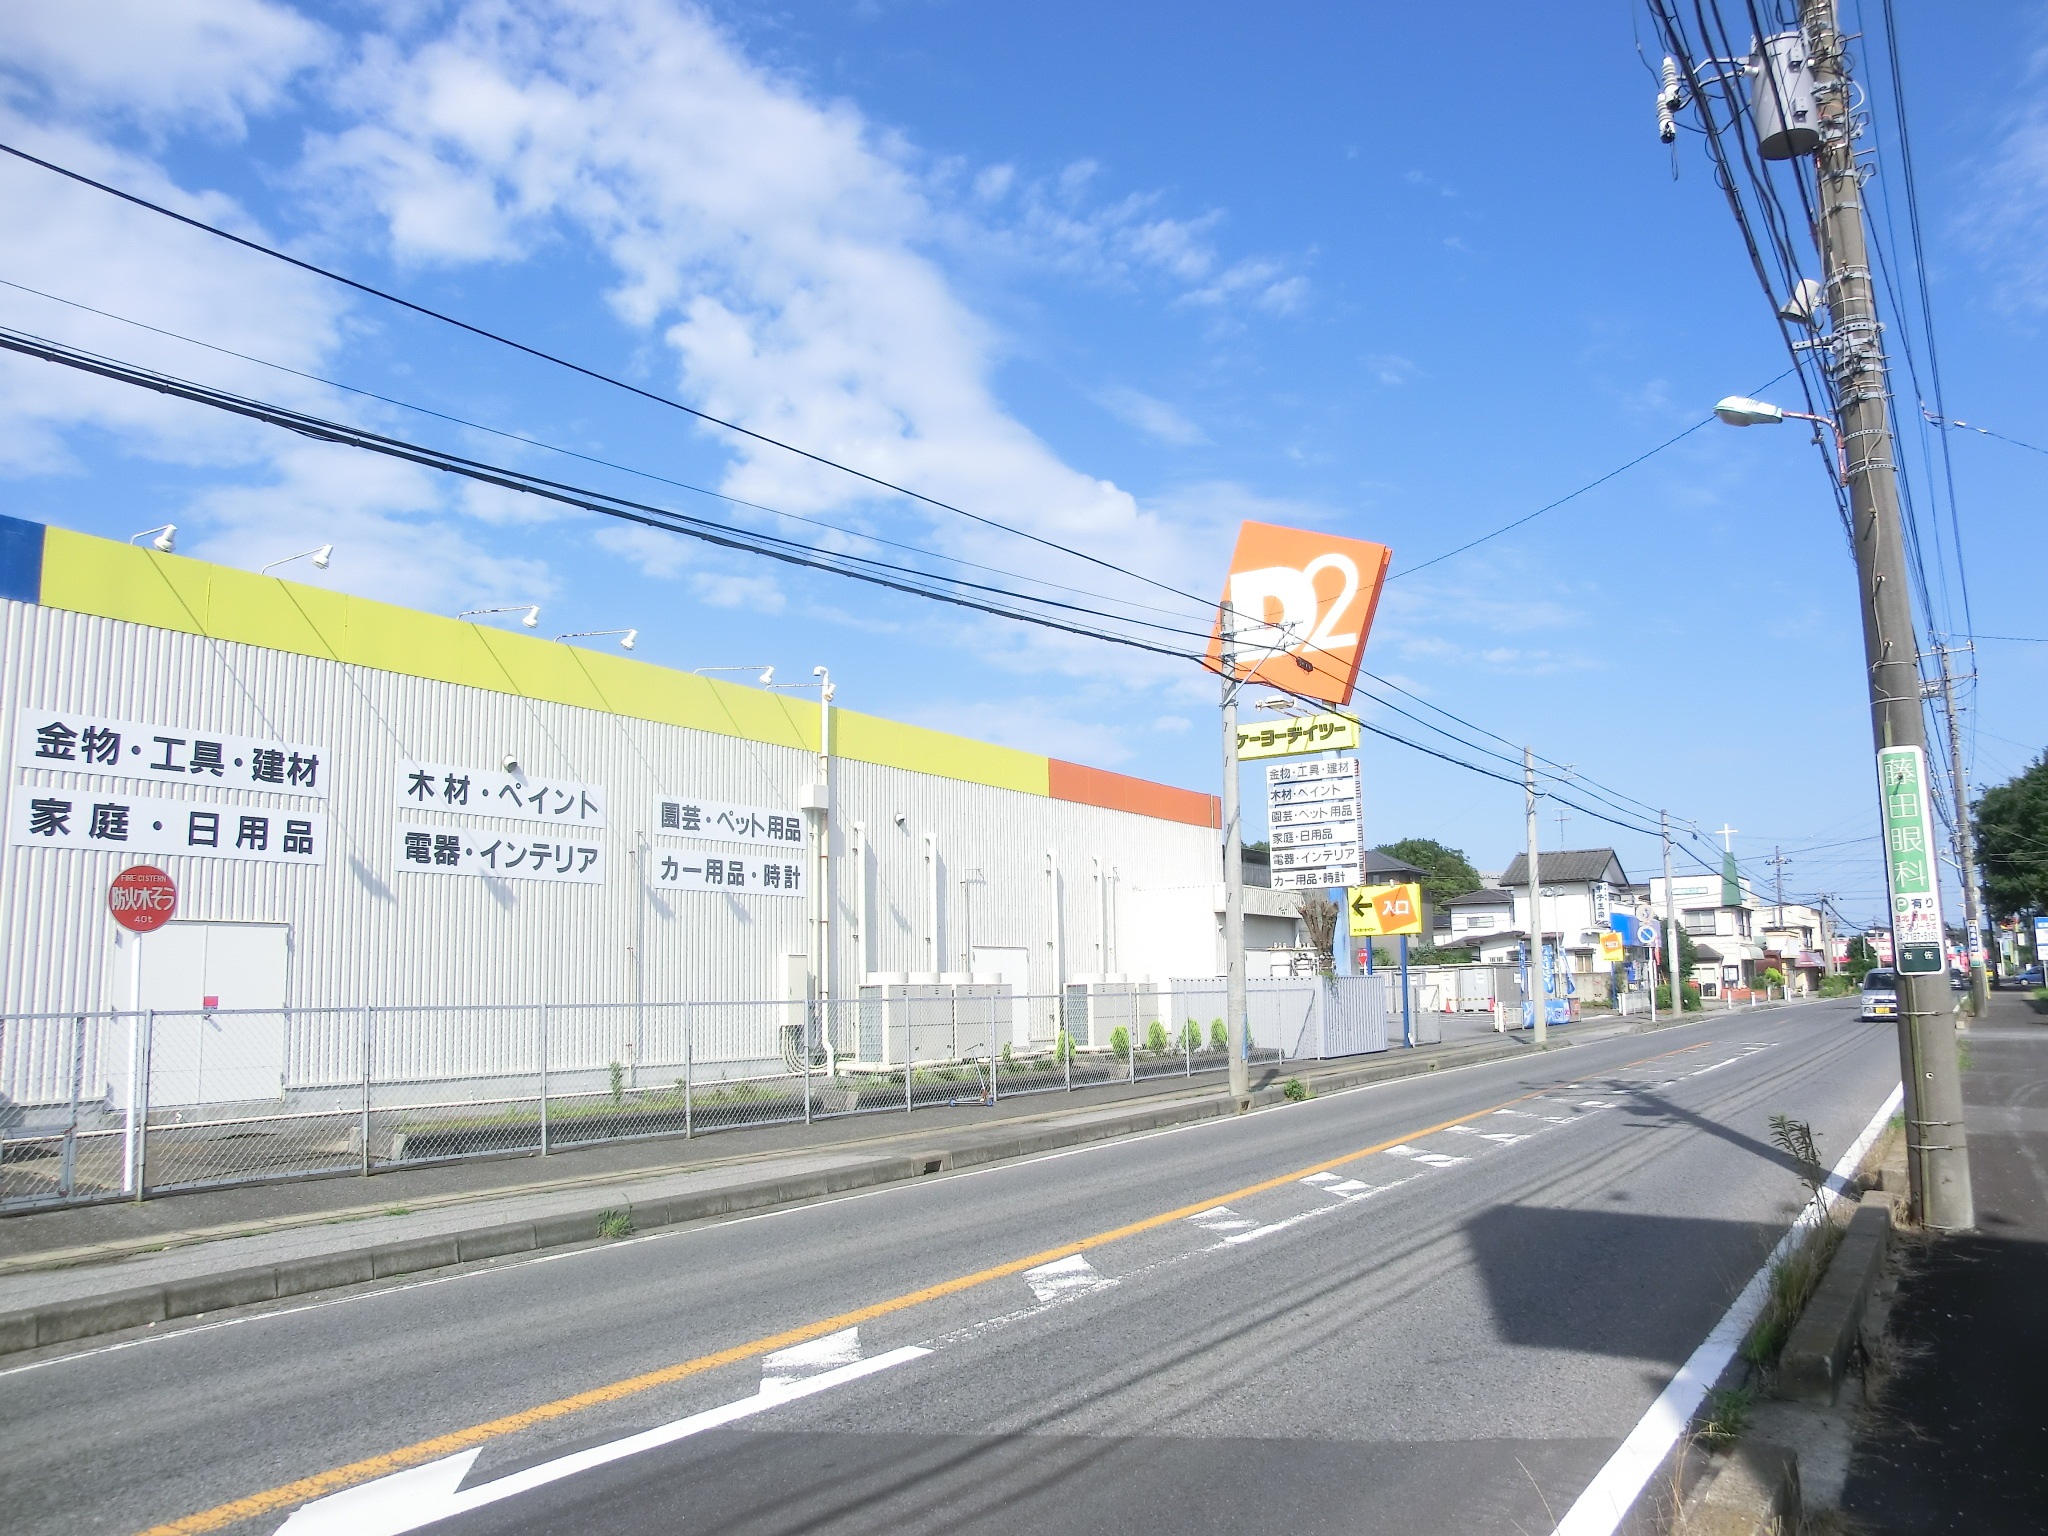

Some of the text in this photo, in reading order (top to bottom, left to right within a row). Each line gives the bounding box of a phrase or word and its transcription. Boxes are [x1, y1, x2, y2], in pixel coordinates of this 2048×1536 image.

[1230, 553, 1359, 663] D2
[35, 721, 320, 788] 金物・工具・建材
[1269, 760, 1349, 780] 金物・工具・建材
[407, 769, 599, 819] 木材・ペイント
[1270, 784, 1341, 802] 木材・ペイント
[660, 801, 801, 843] 園芸・ペット用品
[1271, 804, 1353, 823] 園芸・ペット用品
[1884, 758, 1927, 888] 藤田眼科
[29, 797, 314, 855] 家庭・日用品
[1272, 828, 1333, 844] 家庭・日用品
[404, 831, 599, 874] 電器・インテリア
[1273, 848, 1355, 866] 電器・インテリア
[120, 874, 167, 882] FIRE CISTERN
[660, 855, 801, 890] カー用品・時計
[1274, 871, 1346, 887] カー用品・時計
[1382, 900, 1409, 915] 入口
[134, 915, 153, 923] 40t
